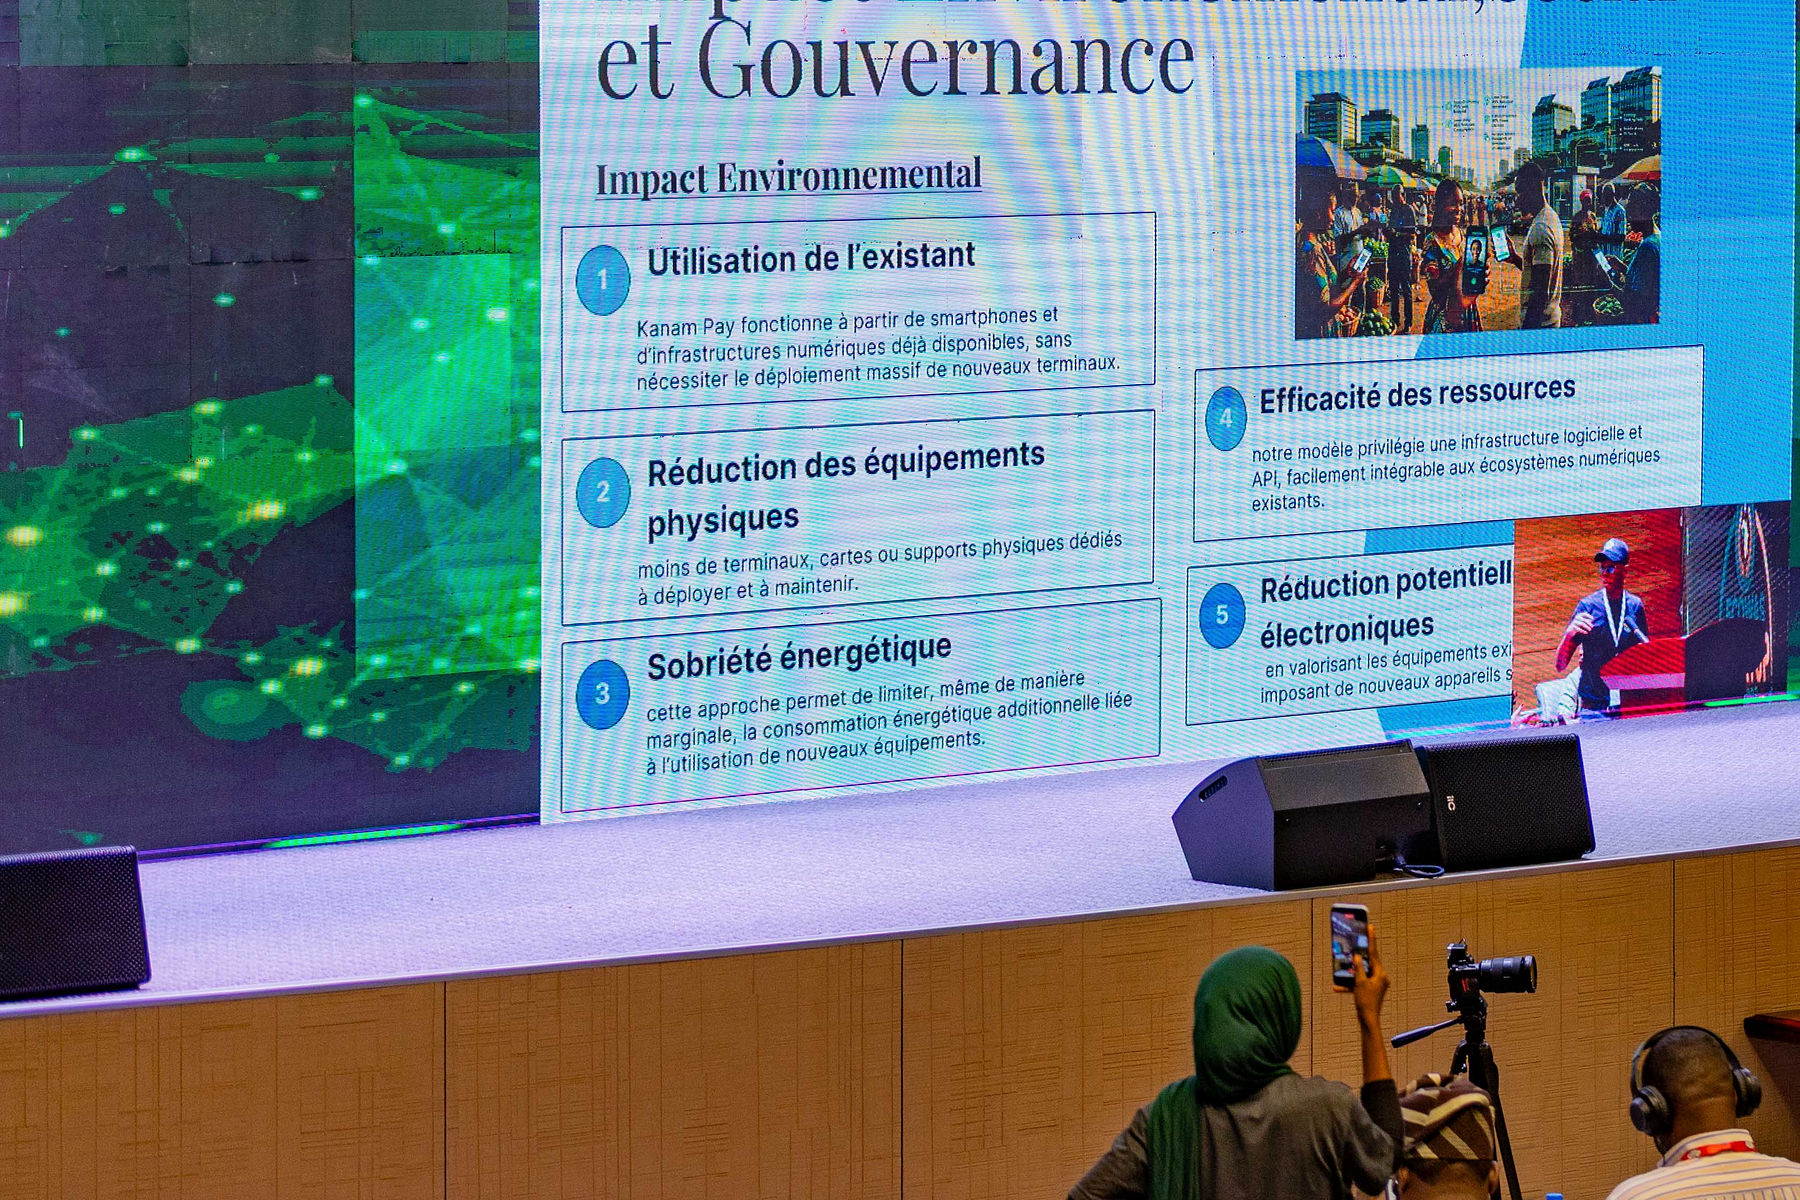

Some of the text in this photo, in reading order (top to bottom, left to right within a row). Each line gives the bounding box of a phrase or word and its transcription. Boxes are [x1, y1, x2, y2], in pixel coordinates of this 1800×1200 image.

[598, 18, 1195, 100] et Gouvernance
[596, 155, 982, 201] Impact Environnemental
[649, 245, 795, 276] Utilisation
[804, 243, 839, 272] de
[597, 268, 607, 290] 1
[637, 306, 1058, 339] Kanam Pay fonctionne à partir de smartphones et
[786, 338, 885, 360] numériques
[891, 335, 926, 358] déjà
[931, 332, 1028, 356] disponibles,
[1035, 333, 1071, 349] sans
[637, 354, 1121, 391] nécessiter le déploiement massif de nouveaux terminaux.
[1261, 378, 1575, 414] Efficacité des ressources
[1219, 409, 1231, 430] 4
[1252, 424, 1642, 463] notre modèle privilégie une infrastructure logicielle et
[649, 442, 1044, 487] Réduction des équipements
[1251, 449, 1660, 490] API, facilement intégrable aux écosystèmes numériques
[597, 480, 609, 502] 2
[1252, 493, 1326, 512] existants.
[649, 504, 799, 544] physiques
[638, 531, 1122, 579] moins de terminaux, cartes ou supports physiques dédiés
[638, 577, 858, 608] à déployer et à maintenir.
[1261, 559, 1512, 603] Réduction potentiell
[1215, 604, 1229, 625] 5
[1261, 614, 1434, 649] électroniques
[648, 634, 951, 681] Sobriété énergétique
[1265, 663, 1283, 679] en
[1288, 654, 1361, 676] valorisant
[1367, 653, 1387, 669] les
[1392, 644, 1487, 670] équipements
[596, 681, 609, 704] 3
[646, 672, 1084, 723] cette approche permet de limiter, même de manière
[1260, 682, 1329, 706] imposant
[1334, 680, 1353, 697] de
[1358, 676, 1429, 695] nouveaux
[1434, 666, 1500, 691] appareils
[646, 692, 1132, 751] marginale, la consommation énergétique additionnelle liée
[646, 757, 655, 776] à
[759, 747, 780, 765] de
[786, 742, 867, 763] nouveaux
[873, 730, 985, 758] équipements.
